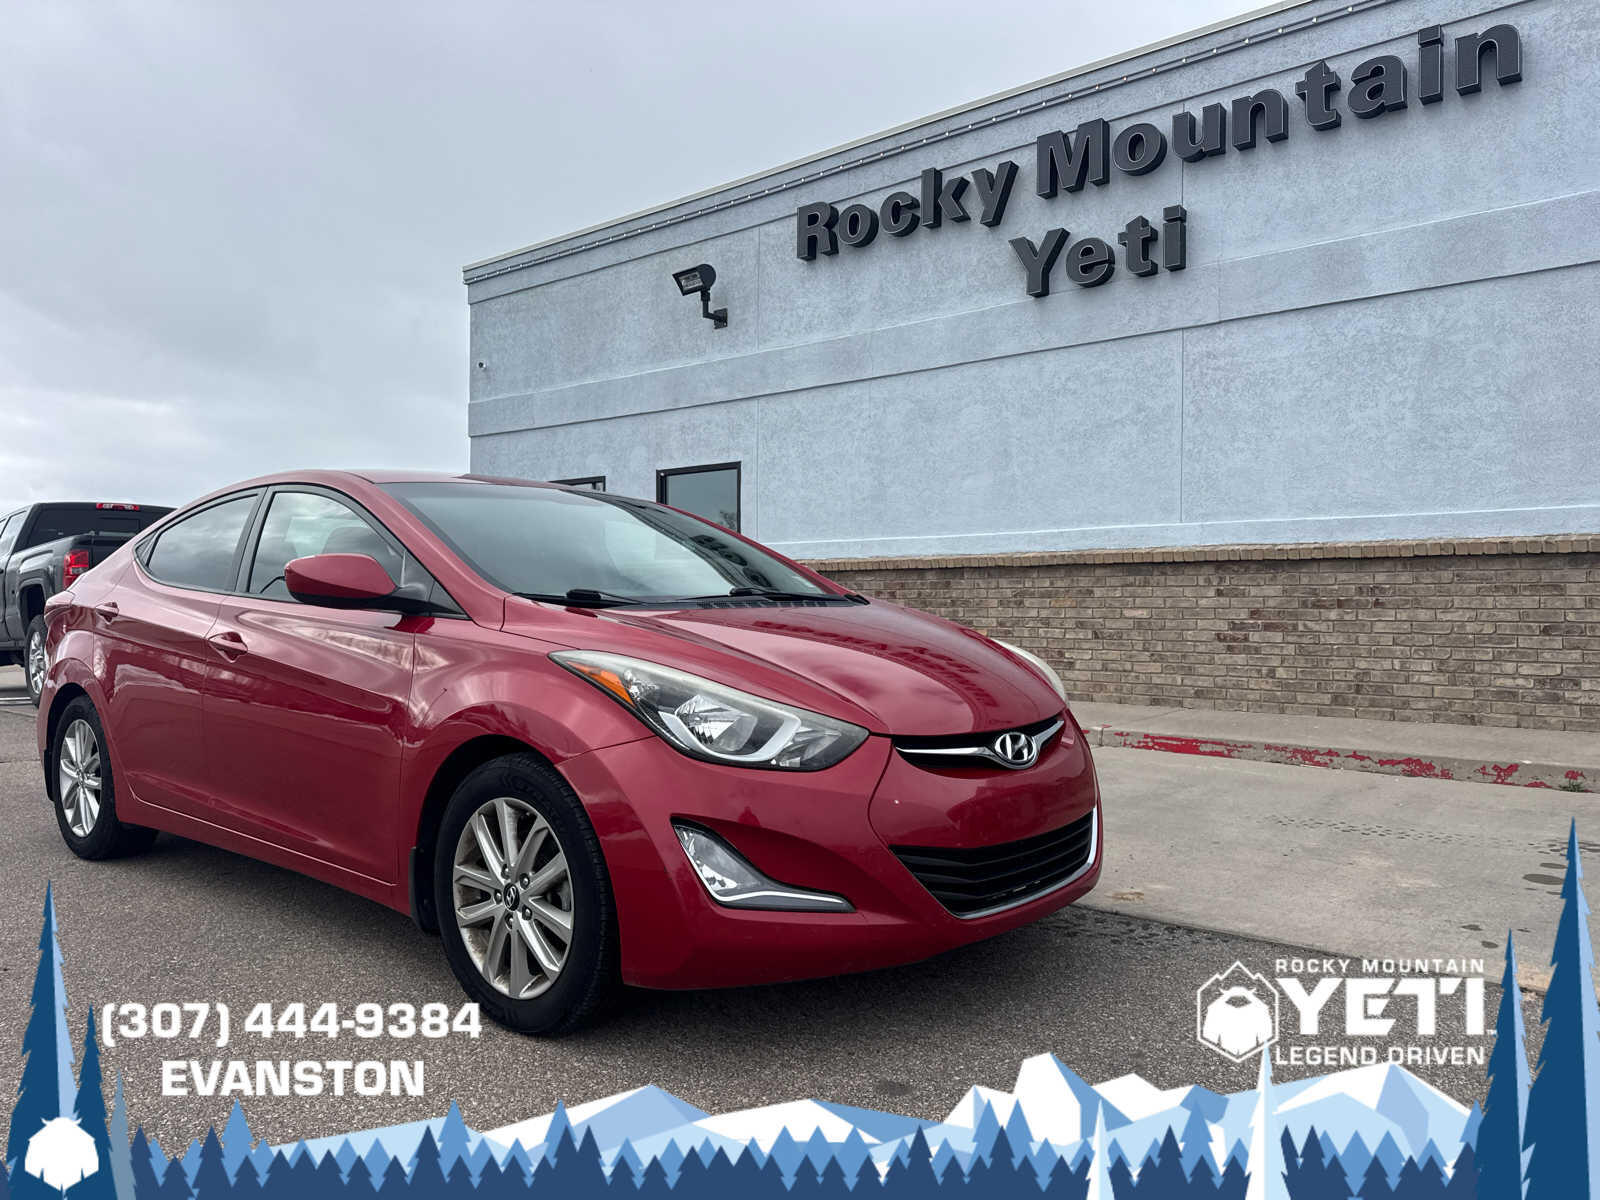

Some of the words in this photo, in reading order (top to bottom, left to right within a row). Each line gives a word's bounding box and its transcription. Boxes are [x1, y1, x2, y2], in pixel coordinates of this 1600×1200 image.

[796, 161, 1018, 260] Rocky
[1036, 24, 1523, 198] Mountain
[1010, 205, 1188, 297] Yeti
